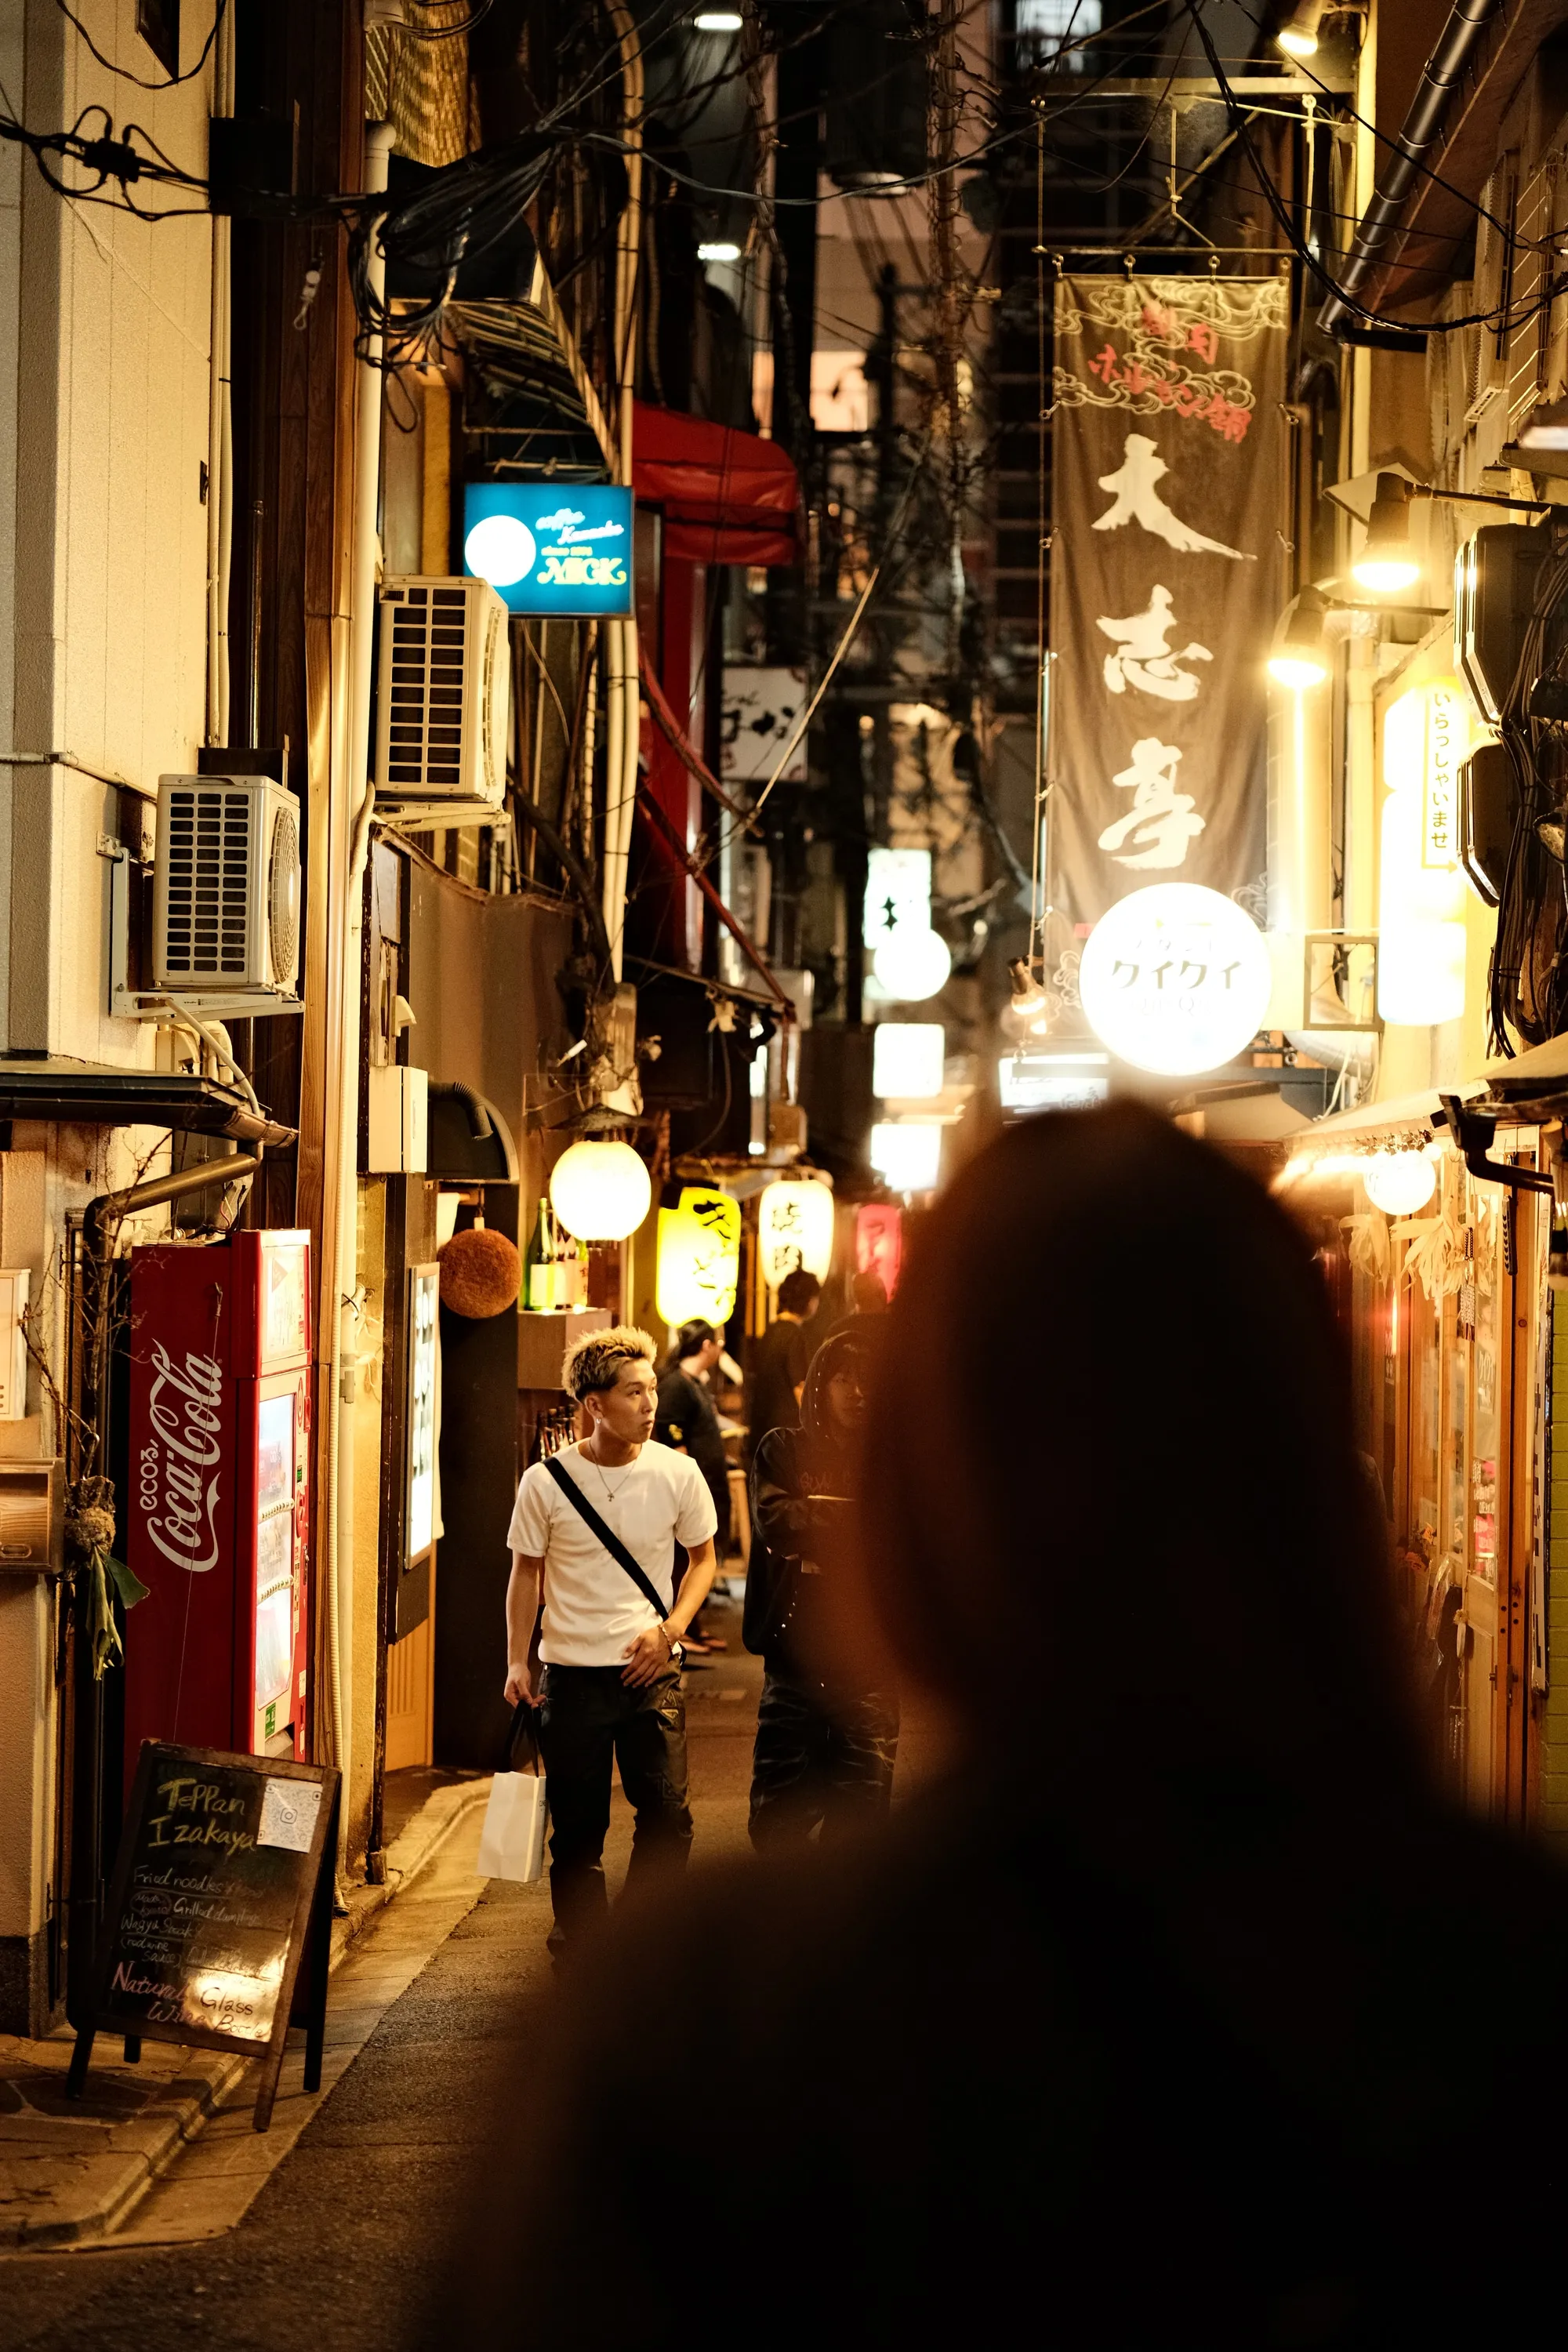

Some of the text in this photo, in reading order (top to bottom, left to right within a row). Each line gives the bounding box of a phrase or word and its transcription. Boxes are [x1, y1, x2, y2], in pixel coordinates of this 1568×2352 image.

[1432, 692, 1450, 849] いらっしゃいませ
[1111, 959, 1243, 990] クイクイ
[147, 1337, 223, 1573] Coca-Cola
[148, 1815, 257, 1856] Izakaya
[134, 1865, 170, 1885] Fried
[173, 1875, 222, 1893] noodles
[173, 1897, 214, 1919] Grilled
[120, 1913, 159, 1934] Wagyu
[111, 1961, 190, 2002] Natural
[147, 2001, 208, 2024] Wine
[200, 1987, 254, 2016] Glass
